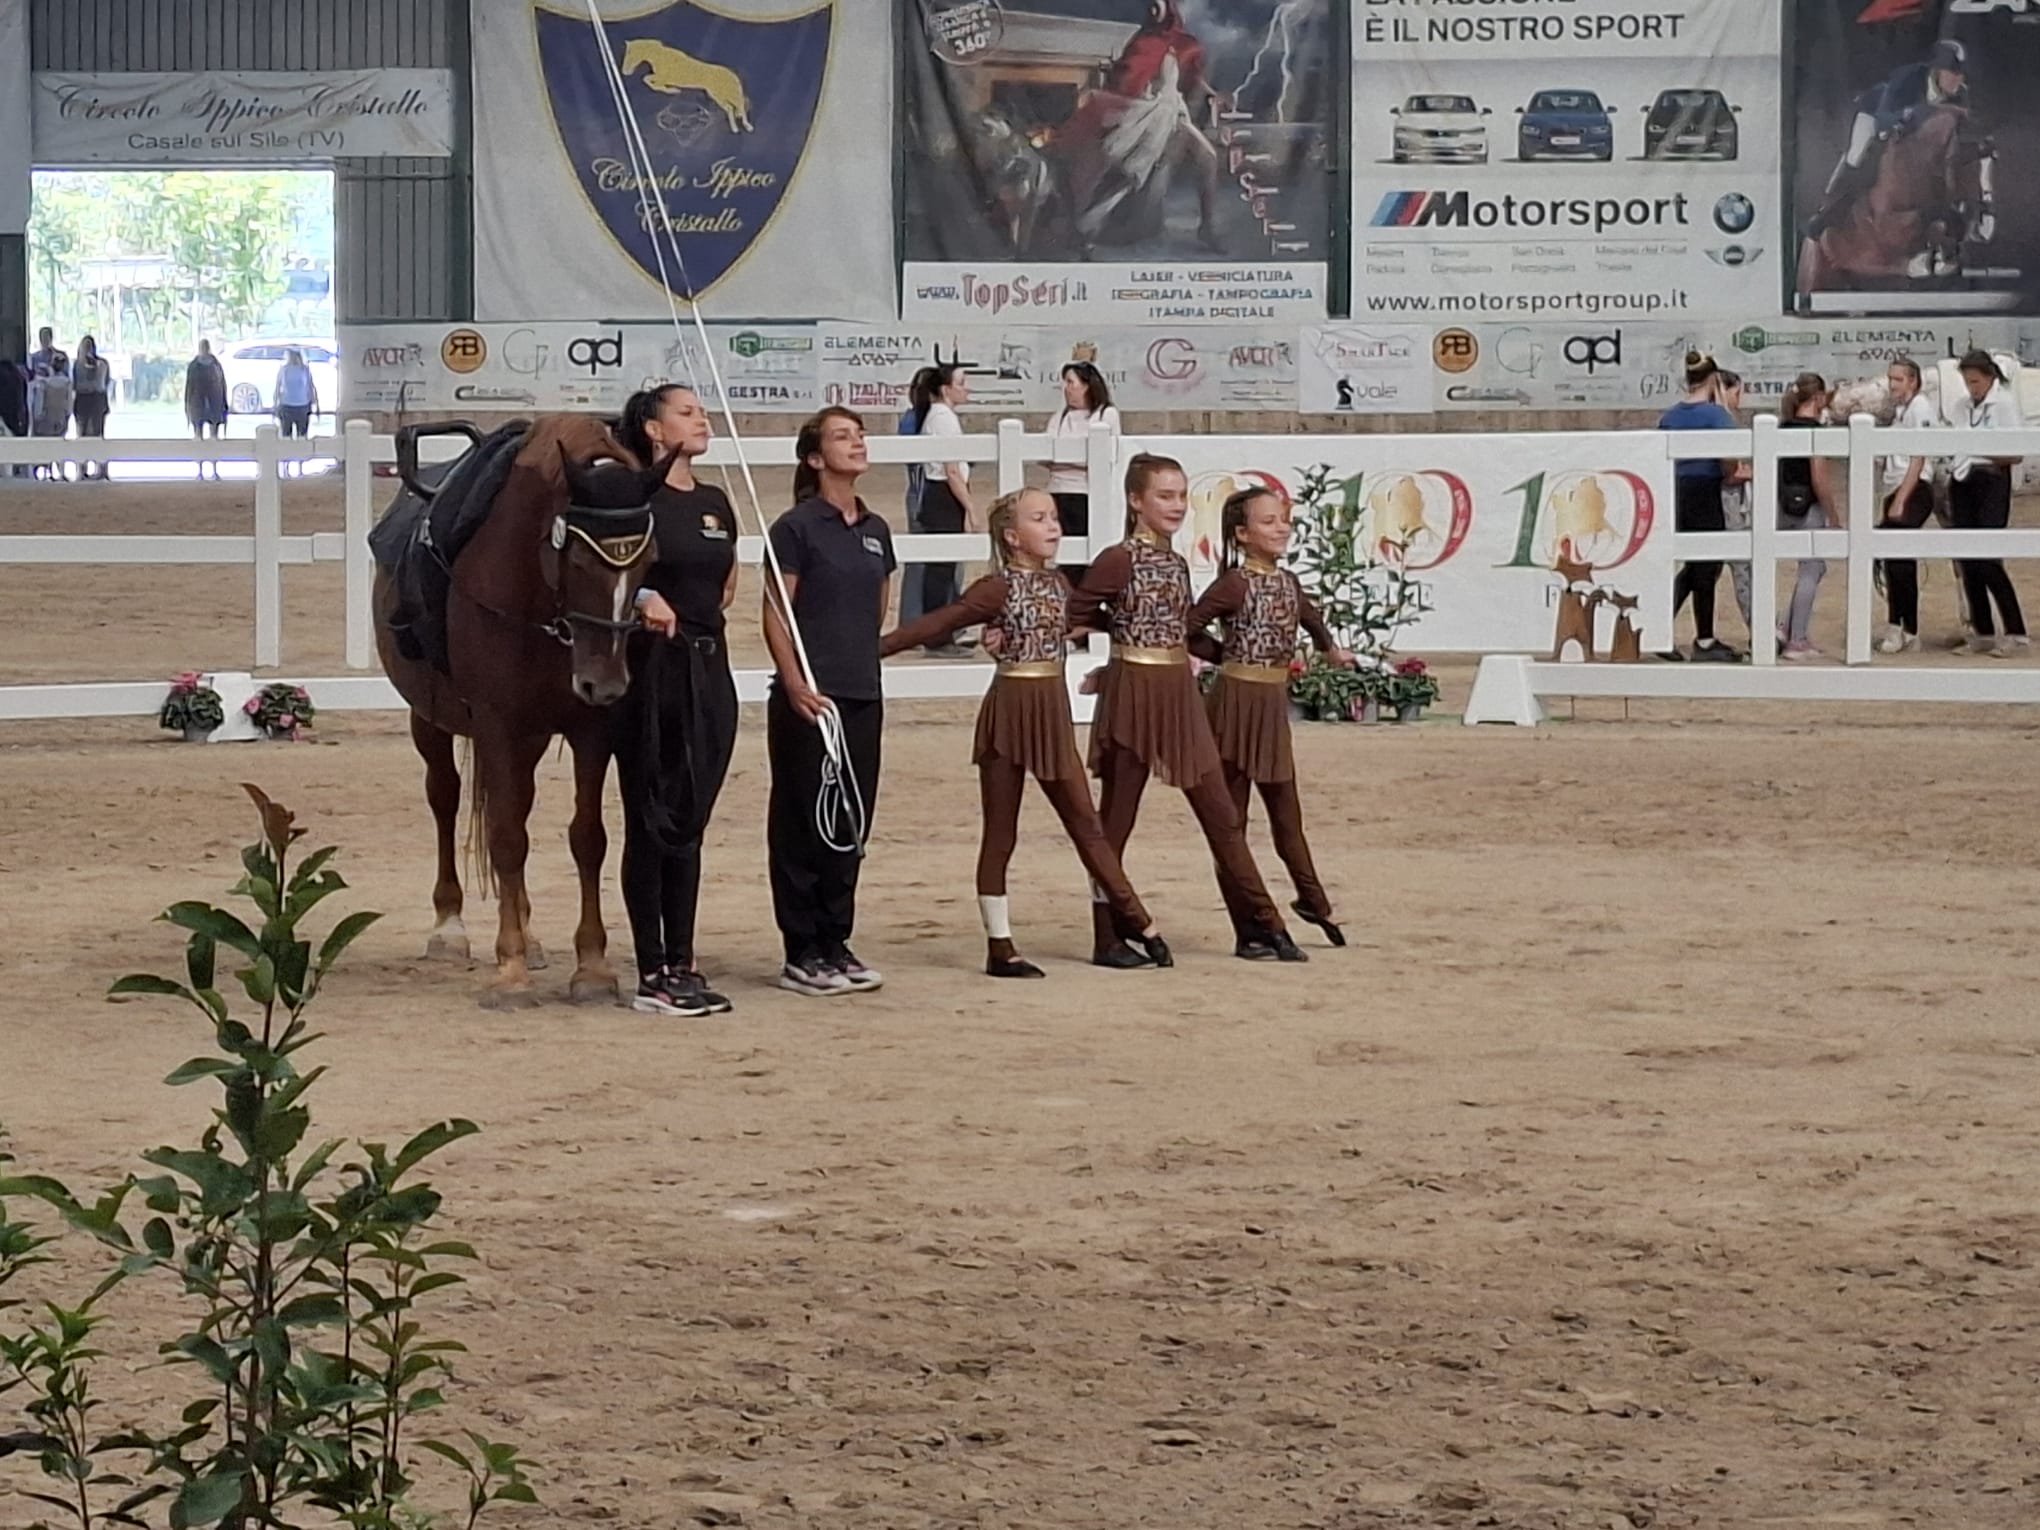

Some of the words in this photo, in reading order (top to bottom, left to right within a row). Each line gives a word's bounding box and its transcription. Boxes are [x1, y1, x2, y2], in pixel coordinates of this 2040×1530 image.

[1366, 12, 1384, 42] È
[1393, 18, 1419, 42] IL
[1427, 16, 1564, 42] NOSTRO
[1573, 14, 1685, 40] SPORT
[127, 132, 203, 149] Casale
[211, 133, 241, 149] sul
[297, 131, 345, 149] (TV)
[1415, 190, 1689, 233] Motorsport
[1367, 291, 1688, 314] www.motorsportgroup.it
